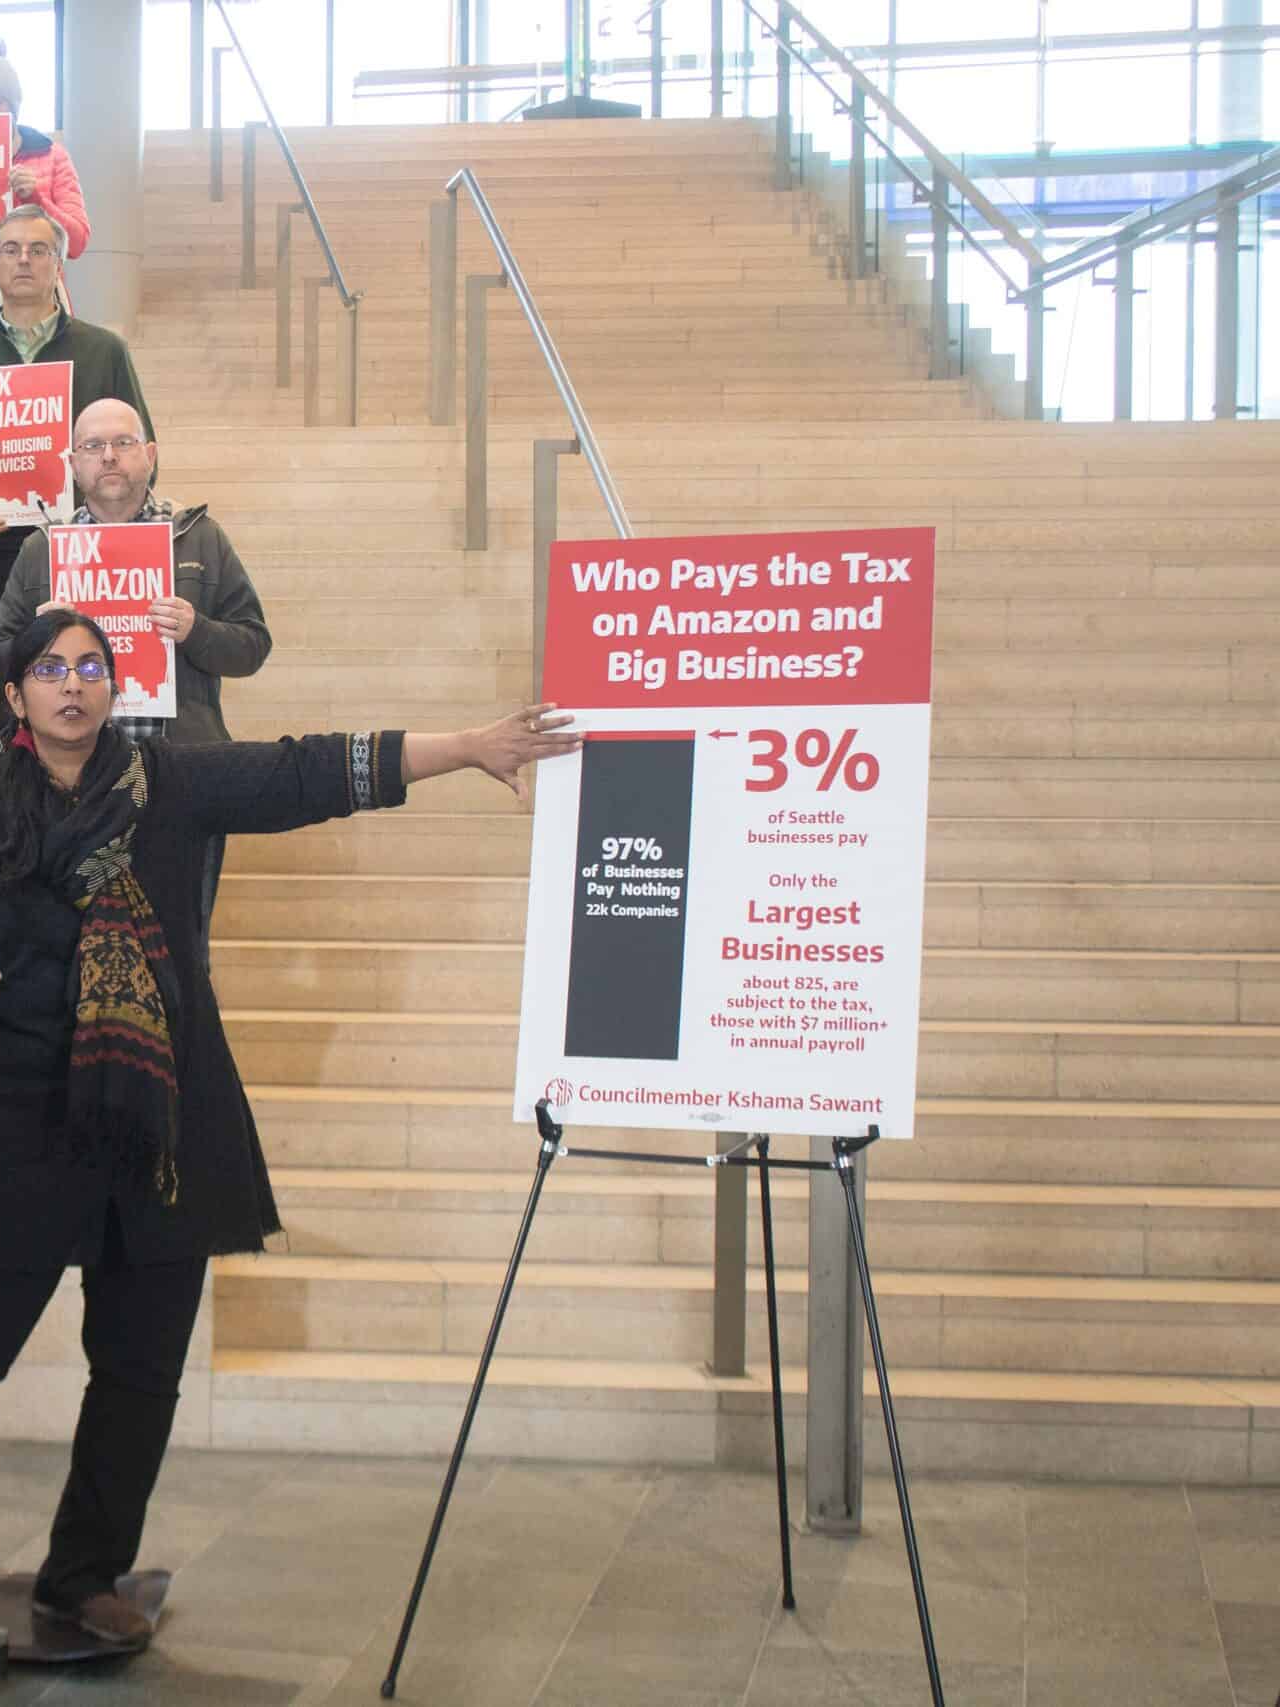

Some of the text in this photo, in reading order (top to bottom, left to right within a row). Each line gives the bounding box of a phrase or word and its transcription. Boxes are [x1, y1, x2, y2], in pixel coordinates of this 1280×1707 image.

[3, 436, 52, 453] HOUSING
[53, 531, 102, 564] TAX
[571, 552, 912, 596] Who Pays the Tax
[55, 568, 164, 603] AMAZON
[592, 596, 883, 636] on Amazon and
[608, 646, 864, 690] Big Business?
[745, 729, 879, 792] 3%
[768, 810, 845, 824] of Seattle
[602, 837, 662, 860] 97%
[748, 830, 867, 847] businesses pay
[582, 864, 684, 878] of Businesses
[587, 882, 680, 899] Pay Nothing
[769, 874, 837, 890] Only the
[586, 904, 679, 918] 22k Companies
[748, 900, 861, 930] Largest
[721, 936, 884, 963] Businesses
[743, 976, 859, 992] about 825, are
[727, 995, 873, 1013] subject to the tax,
[710, 1014, 888, 1032] those with $7 million+
[731, 1034, 864, 1054] in annual payroll
[579, 1085, 882, 1113] Councilmember Kshama Sawant
